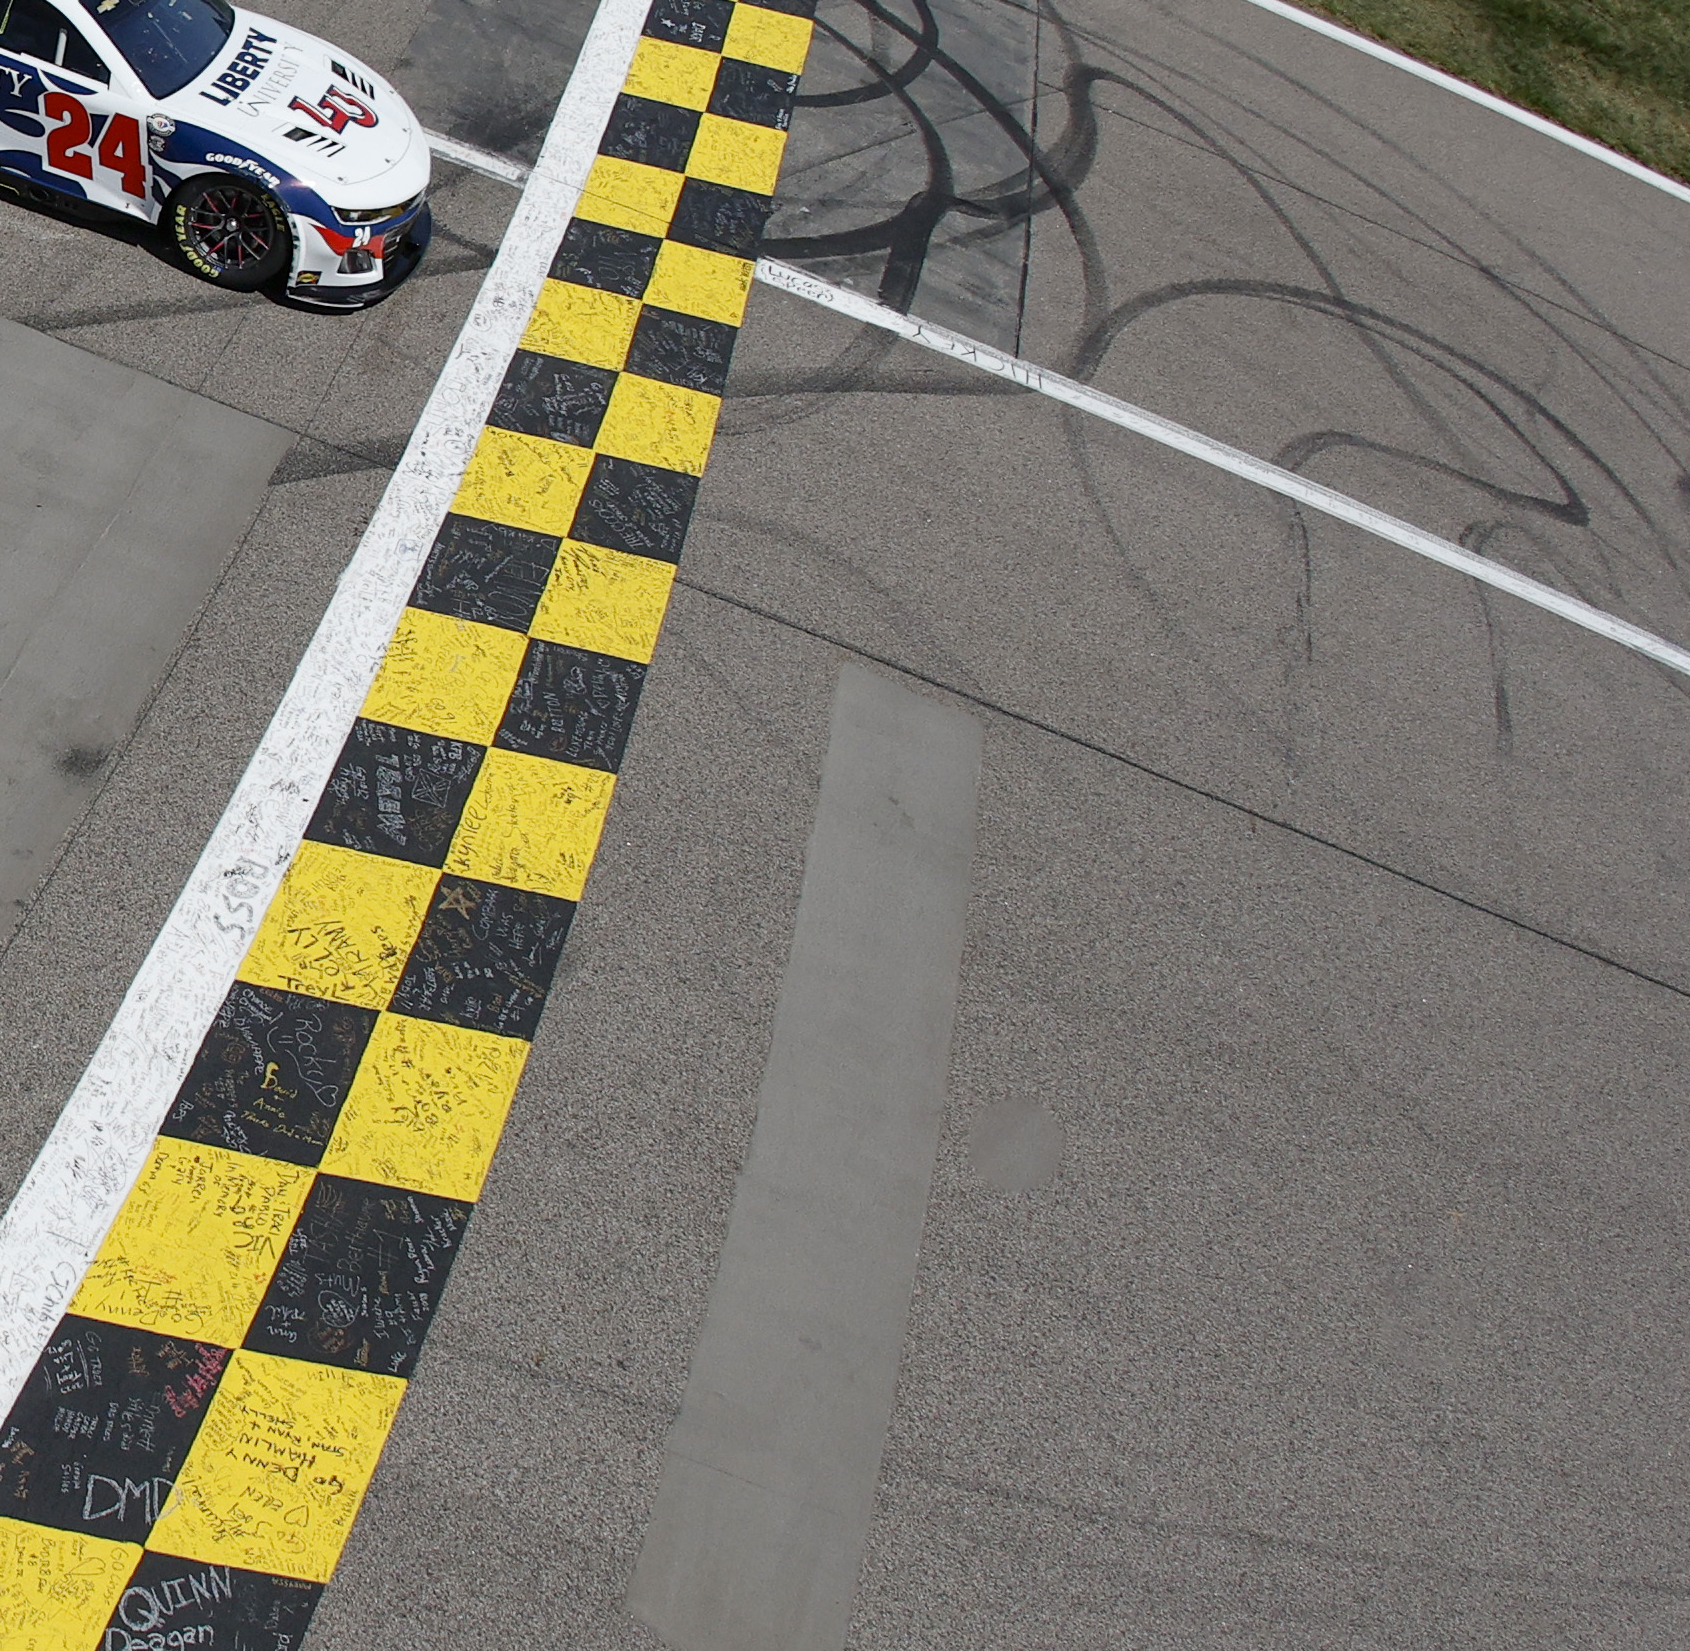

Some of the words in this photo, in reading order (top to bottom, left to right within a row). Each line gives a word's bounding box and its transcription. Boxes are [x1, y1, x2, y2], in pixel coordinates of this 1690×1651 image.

[200, 26, 279, 107] LIBERTY
[237, 41, 305, 119] UNIVERSITY
[43, 91, 147, 200] 24
[205, 151, 281, 188] GOODYEAR
[173, 205, 221, 279] GOODYEAR
[353, 226, 371, 248] 24
[213, 855, 270, 942] ROSS
[238, 1433, 317, 1469] HAMLIN
[266, 1425, 303, 1444] RYAN
[225, 1449, 301, 1483] DENNY
[83, 1474, 184, 1525] DMD
[118, 1565, 234, 1633] QUINN
